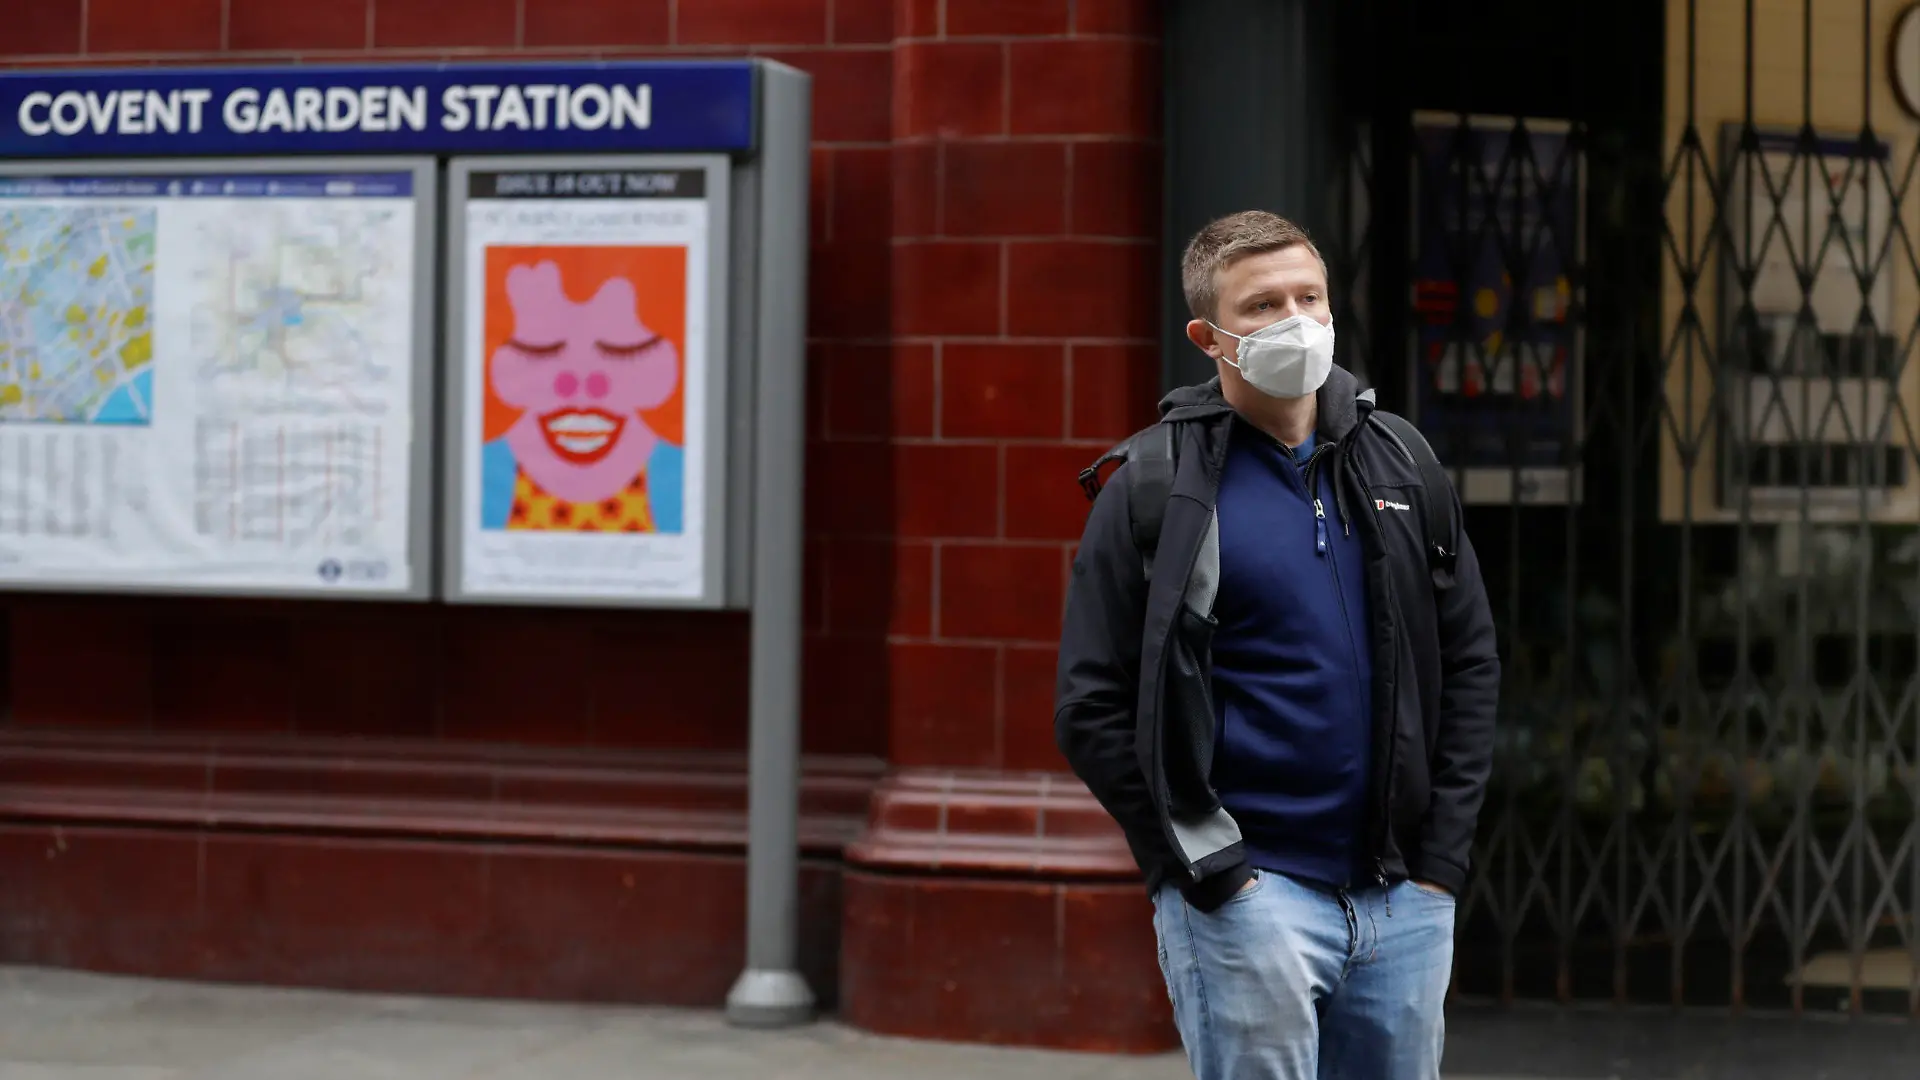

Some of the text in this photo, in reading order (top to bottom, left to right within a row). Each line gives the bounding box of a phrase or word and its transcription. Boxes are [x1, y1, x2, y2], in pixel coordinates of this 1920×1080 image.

[18, 83, 651, 136] COVENT GARDEN STATION
